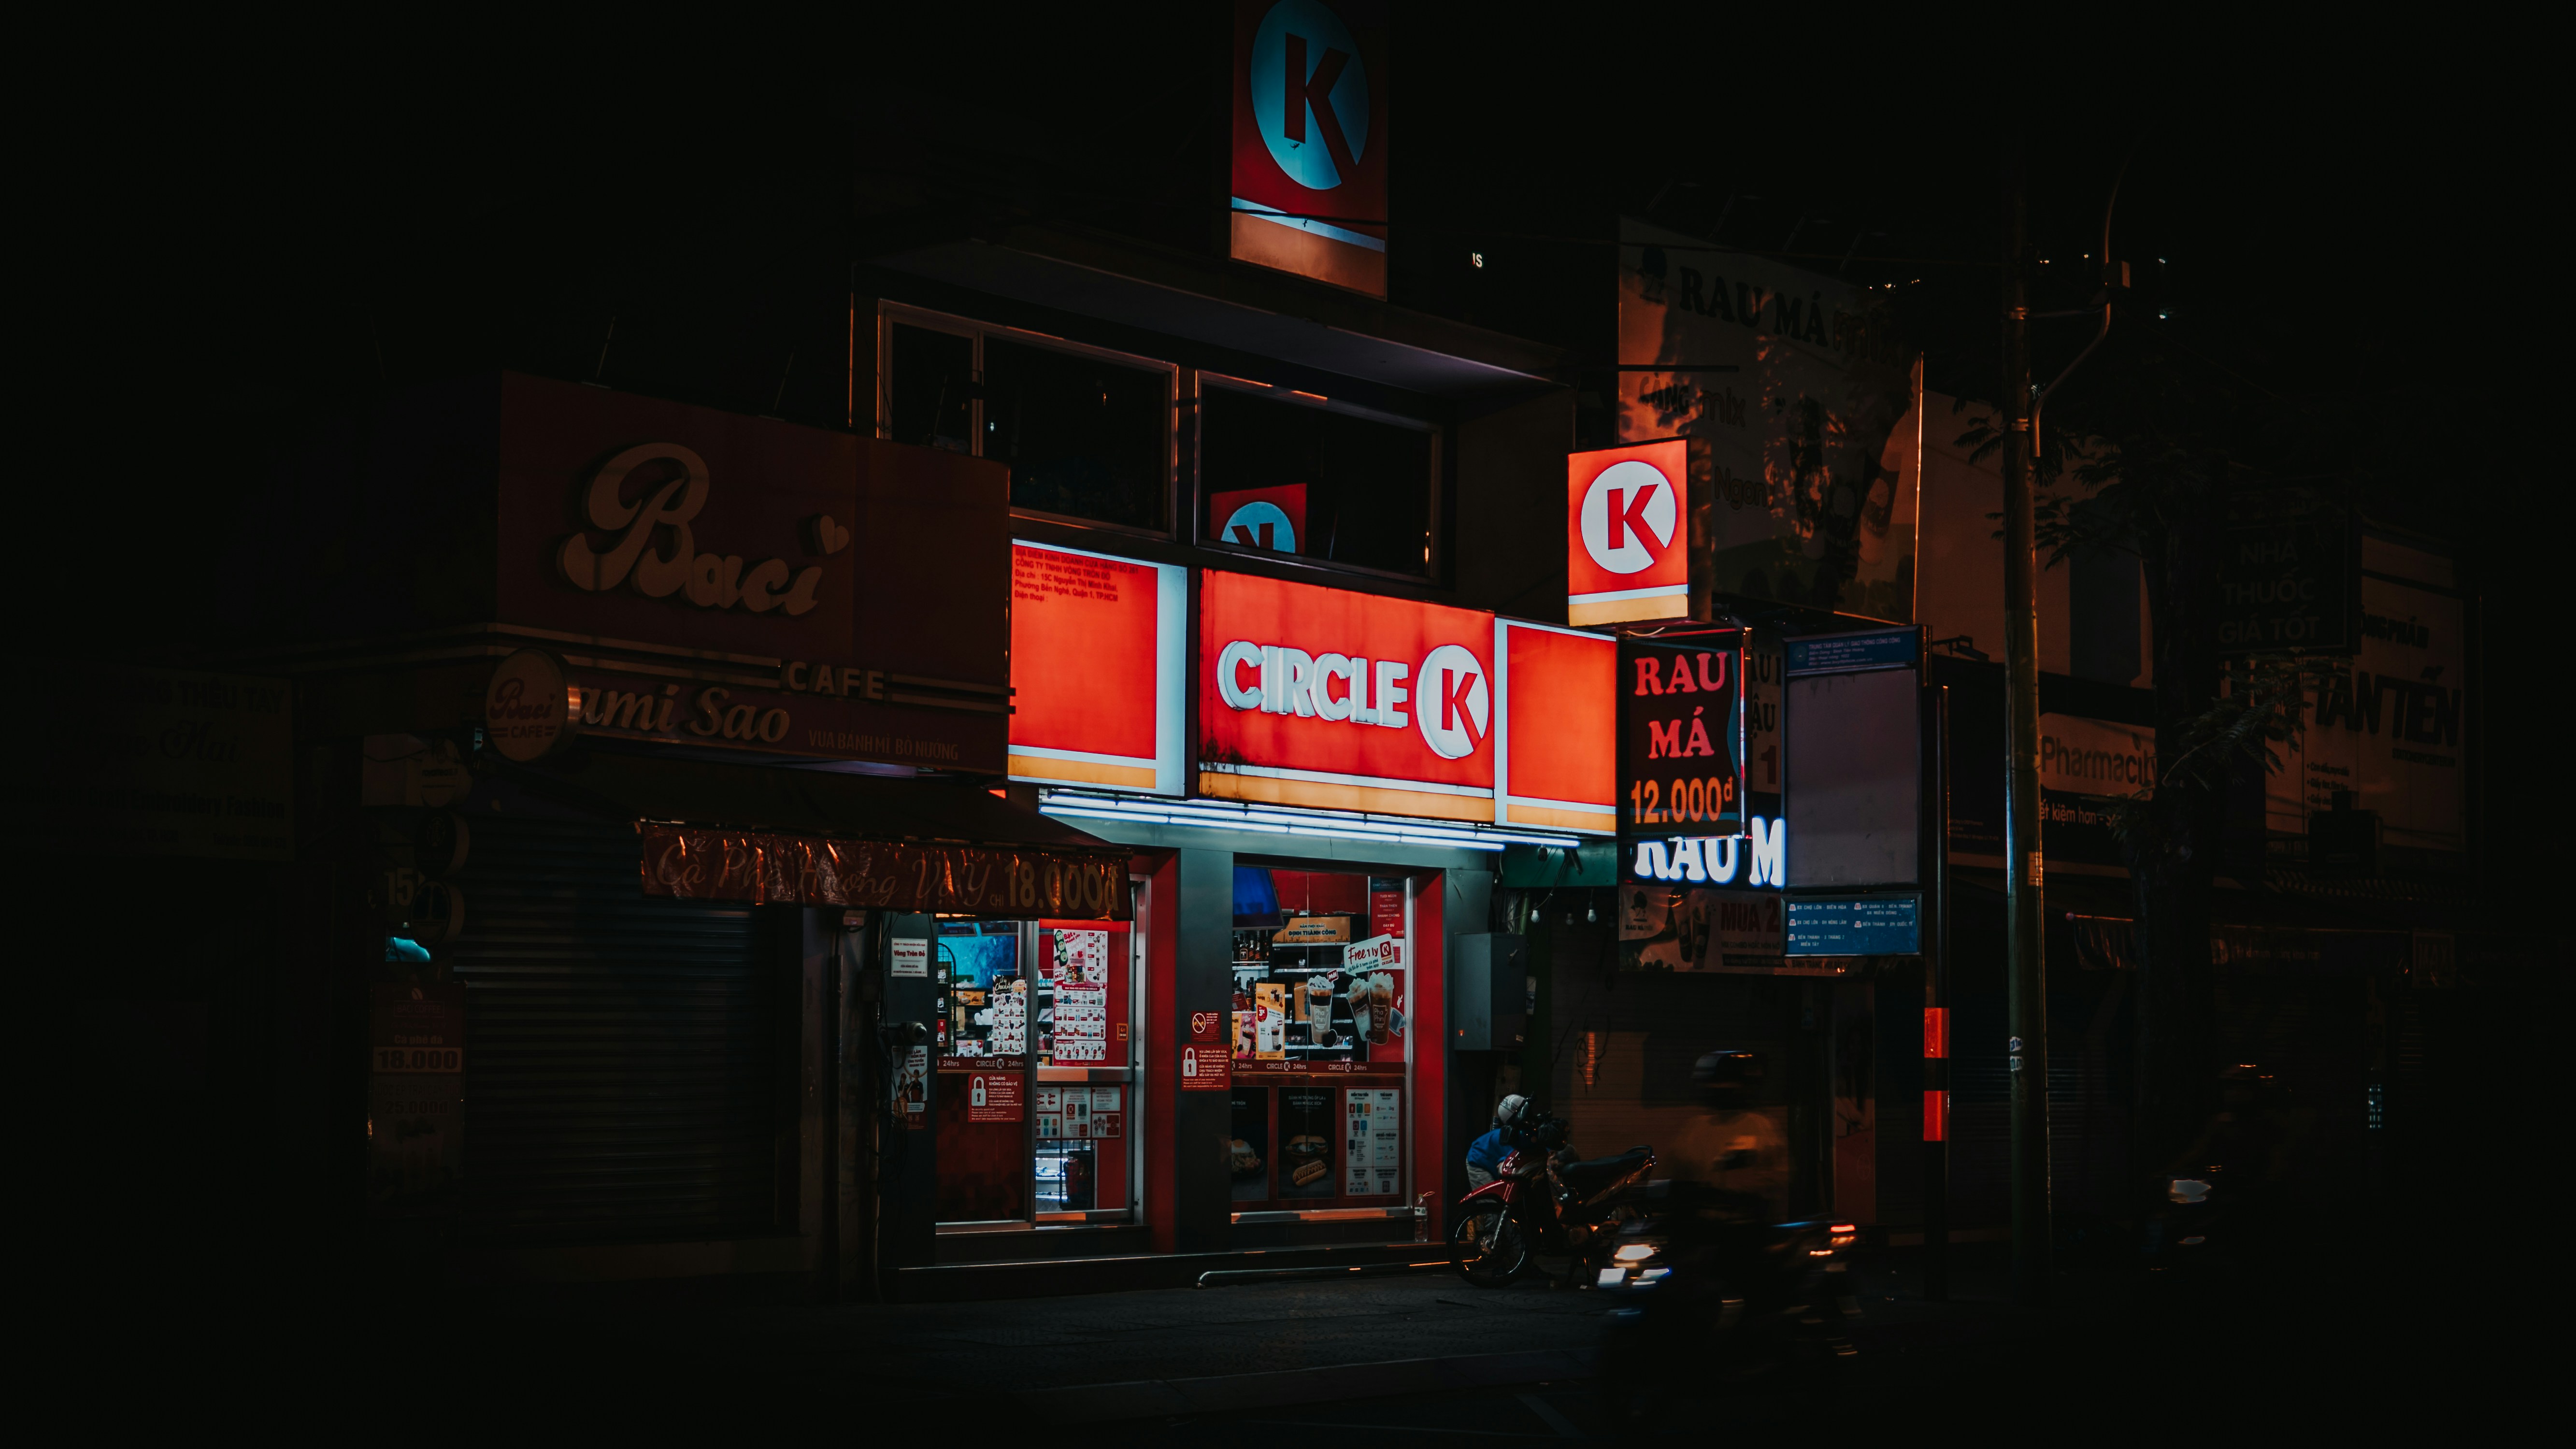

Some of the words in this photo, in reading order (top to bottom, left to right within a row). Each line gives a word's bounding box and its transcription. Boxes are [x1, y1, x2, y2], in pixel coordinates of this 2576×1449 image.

[1285, 32, 1357, 184] K
[1680, 266, 1763, 328] RAU
[1774, 290, 1828, 347] MÁ
[1699, 387, 1746, 427] mix
[557, 442, 849, 616] Baci
[1608, 484, 1667, 563] K
[1042, 574, 1052, 582] 15C
[1045, 563, 1062, 573] TNHH
[2221, 566, 2315, 606] THUỐC
[2218, 612, 2262, 644] GIÁ
[2269, 604, 2320, 641] TỐT
[780, 660, 886, 701] CAFE
[1217, 640, 1409, 729] CIRCLE
[1634, 652, 1729, 697] RAU
[178, 677, 237, 710] THÊU
[243, 685, 285, 714] TAY
[488, 676, 556, 722] Baci
[684, 686, 791, 743] Sao
[2383, 665, 2462, 747] TIẾN
[511, 725, 543, 738] CAFE
[808, 729, 834, 749] VUA
[838, 729, 873, 753] BÁNH
[874, 732, 890, 754] MÌ
[895, 732, 913, 756] BÒ
[915, 735, 959, 761] NƯỚNG
[1648, 706, 1715, 759] MÁ
[131, 789, 221, 818] Embroidery
[227, 795, 285, 819] Fashion
[1630, 776, 1733, 825] 12.000đ
[2052, 802, 2075, 826] kiệm
[2078, 805, 2097, 825] hơn
[384, 868, 414, 906] 15
[1004, 861, 1119, 913] 18.000đ
[1721, 903, 1760, 932] MUA
[1765, 897, 1780, 933] 2
[1348, 947, 1366, 964] Free
[1372, 947, 1378, 957] ly
[415, 1004, 441, 1014] COFFEE
[394, 1034, 407, 1044] Cà
[409, 1034, 428, 1044] phê
[430, 1034, 443, 1044] đá
[378, 1050, 458, 1069] 18.000
